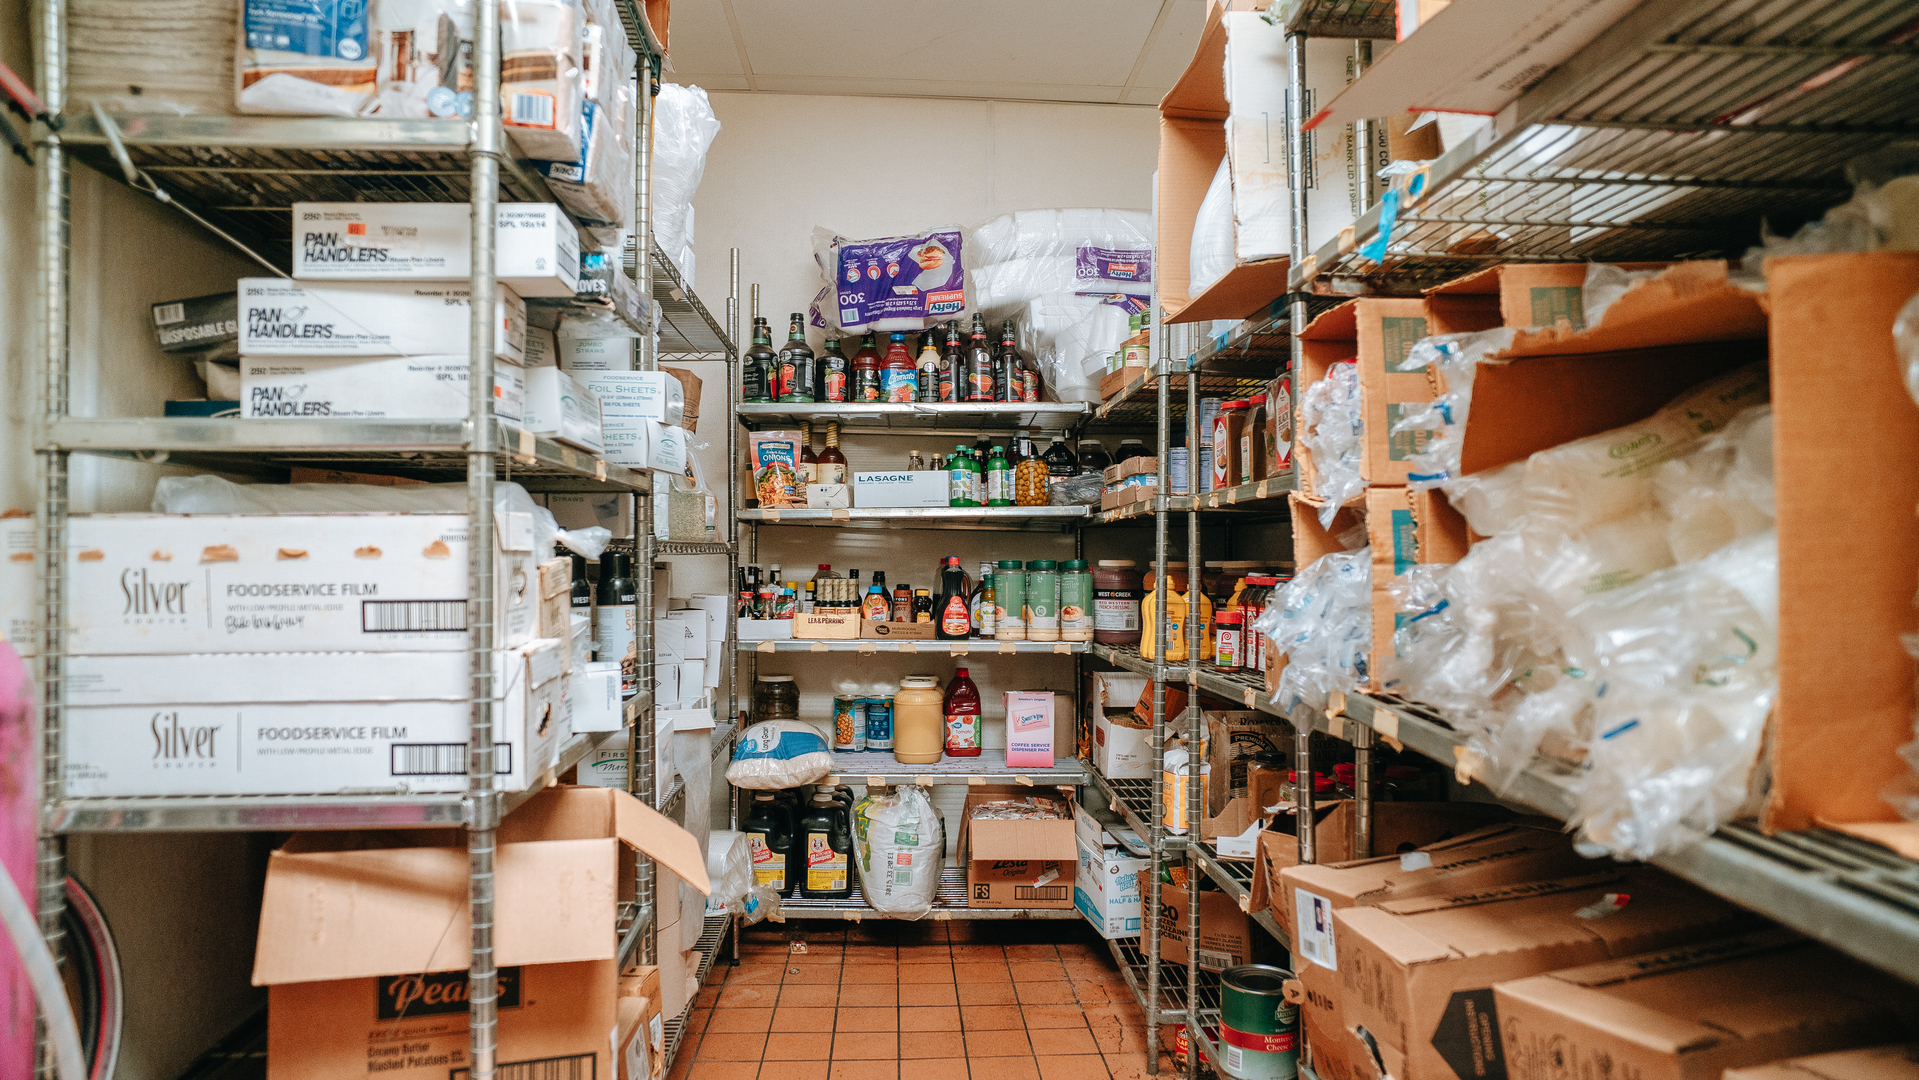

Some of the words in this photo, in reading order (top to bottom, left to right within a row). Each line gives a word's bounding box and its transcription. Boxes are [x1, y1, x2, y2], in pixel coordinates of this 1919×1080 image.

[1346, 56, 1354, 76] USE
[1346, 134, 1354, 162] MARK
[1346, 164, 1354, 180] LID
[1379, 151, 1389, 188] CONT
[304, 232, 338, 246] PAN
[304, 248, 388, 262] HANDLERS
[1078, 268, 1100, 276] 300
[1110, 270, 1132, 278] Hefty
[576, 280, 606, 292] LOVES
[840, 292, 865, 306] 300
[930, 302, 960, 311] Hefty
[248, 308, 282, 323] PAN
[158, 322, 225, 345] DISPOSABLE
[248, 324, 334, 338] HANDLERS
[252, 386, 283, 401] PAN
[588, 384, 612, 394] FOIL
[616, 385, 656, 394] SHEETS
[252, 402, 332, 416] HANDLERS
[762, 454, 791, 462] ONIONS
[858, 474, 914, 482] LASAGNE
[121, 568, 191, 615] Silver
[226, 584, 338, 597] FOODSERVICE
[341, 583, 379, 596] FILM
[151, 710, 222, 760] Silver
[258, 727, 366, 740] FOODSERVICE
[370, 726, 408, 740] FILM
[762, 739, 771, 750] Long
[1235, 735, 1266, 747] PREMIUM
[600, 762, 628, 772] Mark
[992, 860, 1028, 870] Zesta
[1003, 868, 1028, 877] Original
[974, 884, 989, 899] FS
[1160, 918, 1177, 927] OZEN
[1160, 924, 1188, 937] UZAINE
[1160, 932, 1183, 943] OCENA
[1478, 1012, 1496, 1061] OPENING
[1266, 1043, 1288, 1052] Cheese
